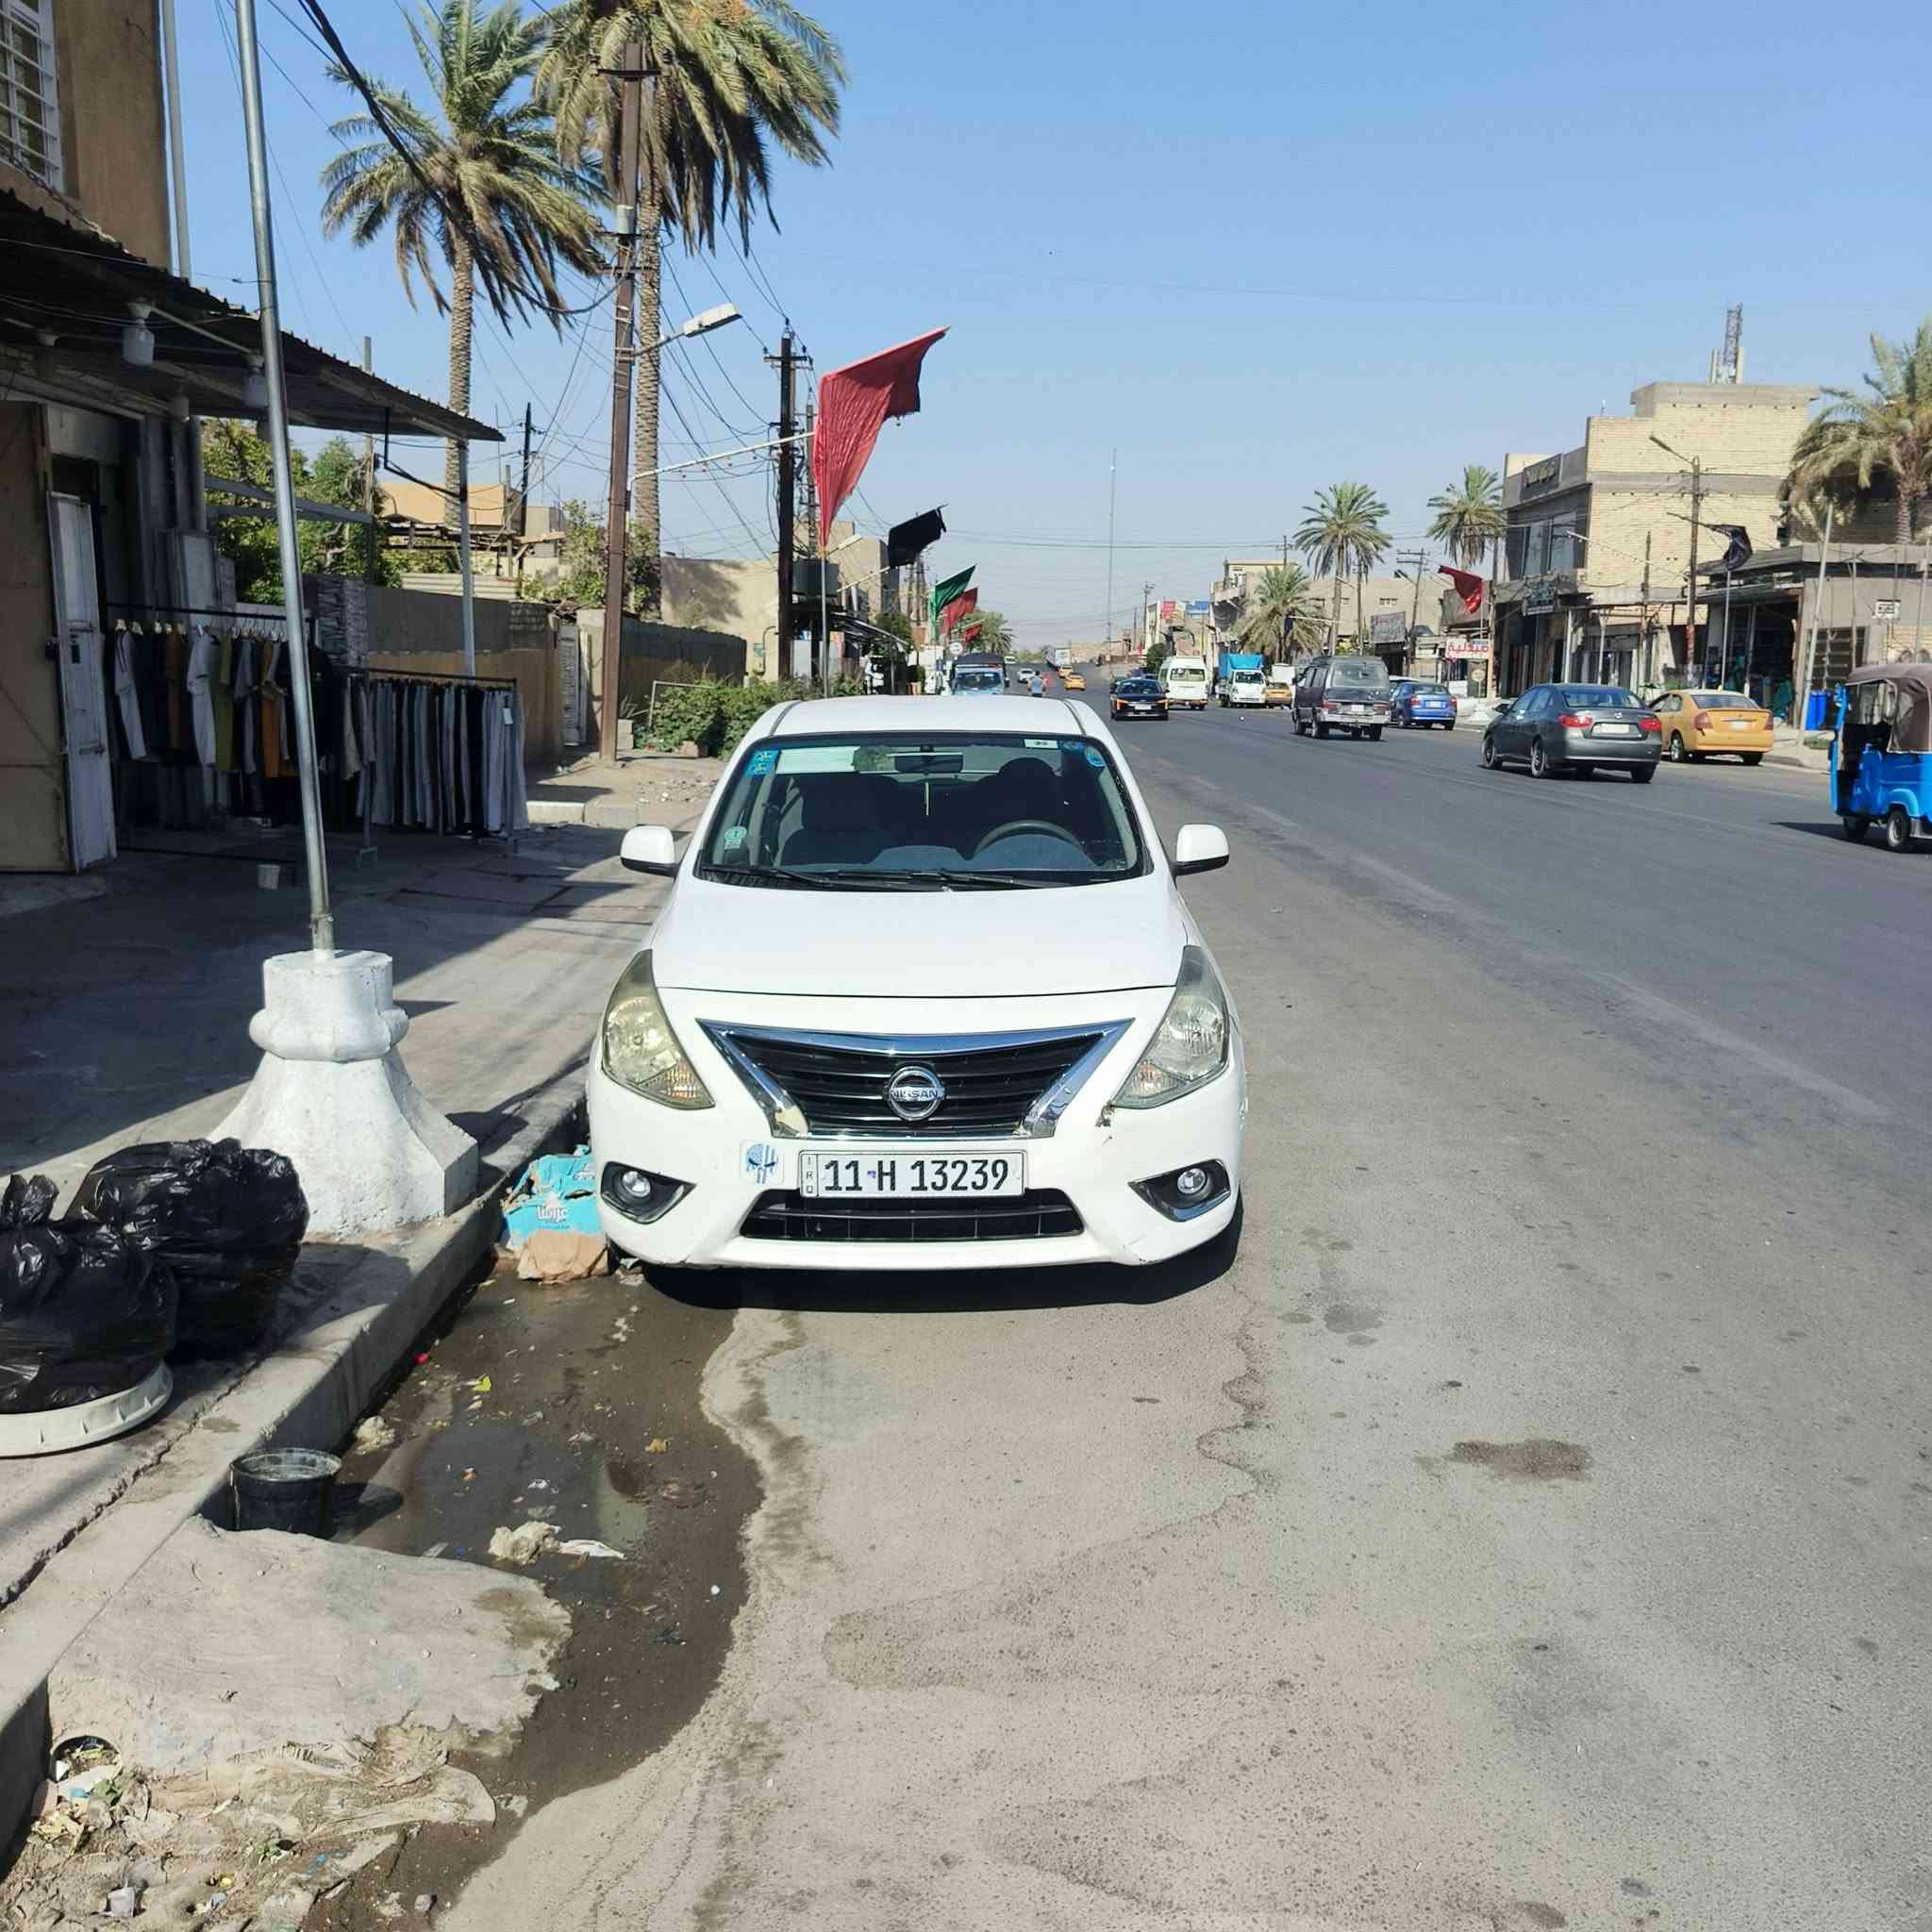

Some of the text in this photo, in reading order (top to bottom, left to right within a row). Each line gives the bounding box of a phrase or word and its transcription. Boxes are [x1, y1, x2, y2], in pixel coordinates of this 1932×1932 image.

[891, 1089, 938, 1099] NISSAN
[824, 1159, 1008, 1191] 11 H 13239
